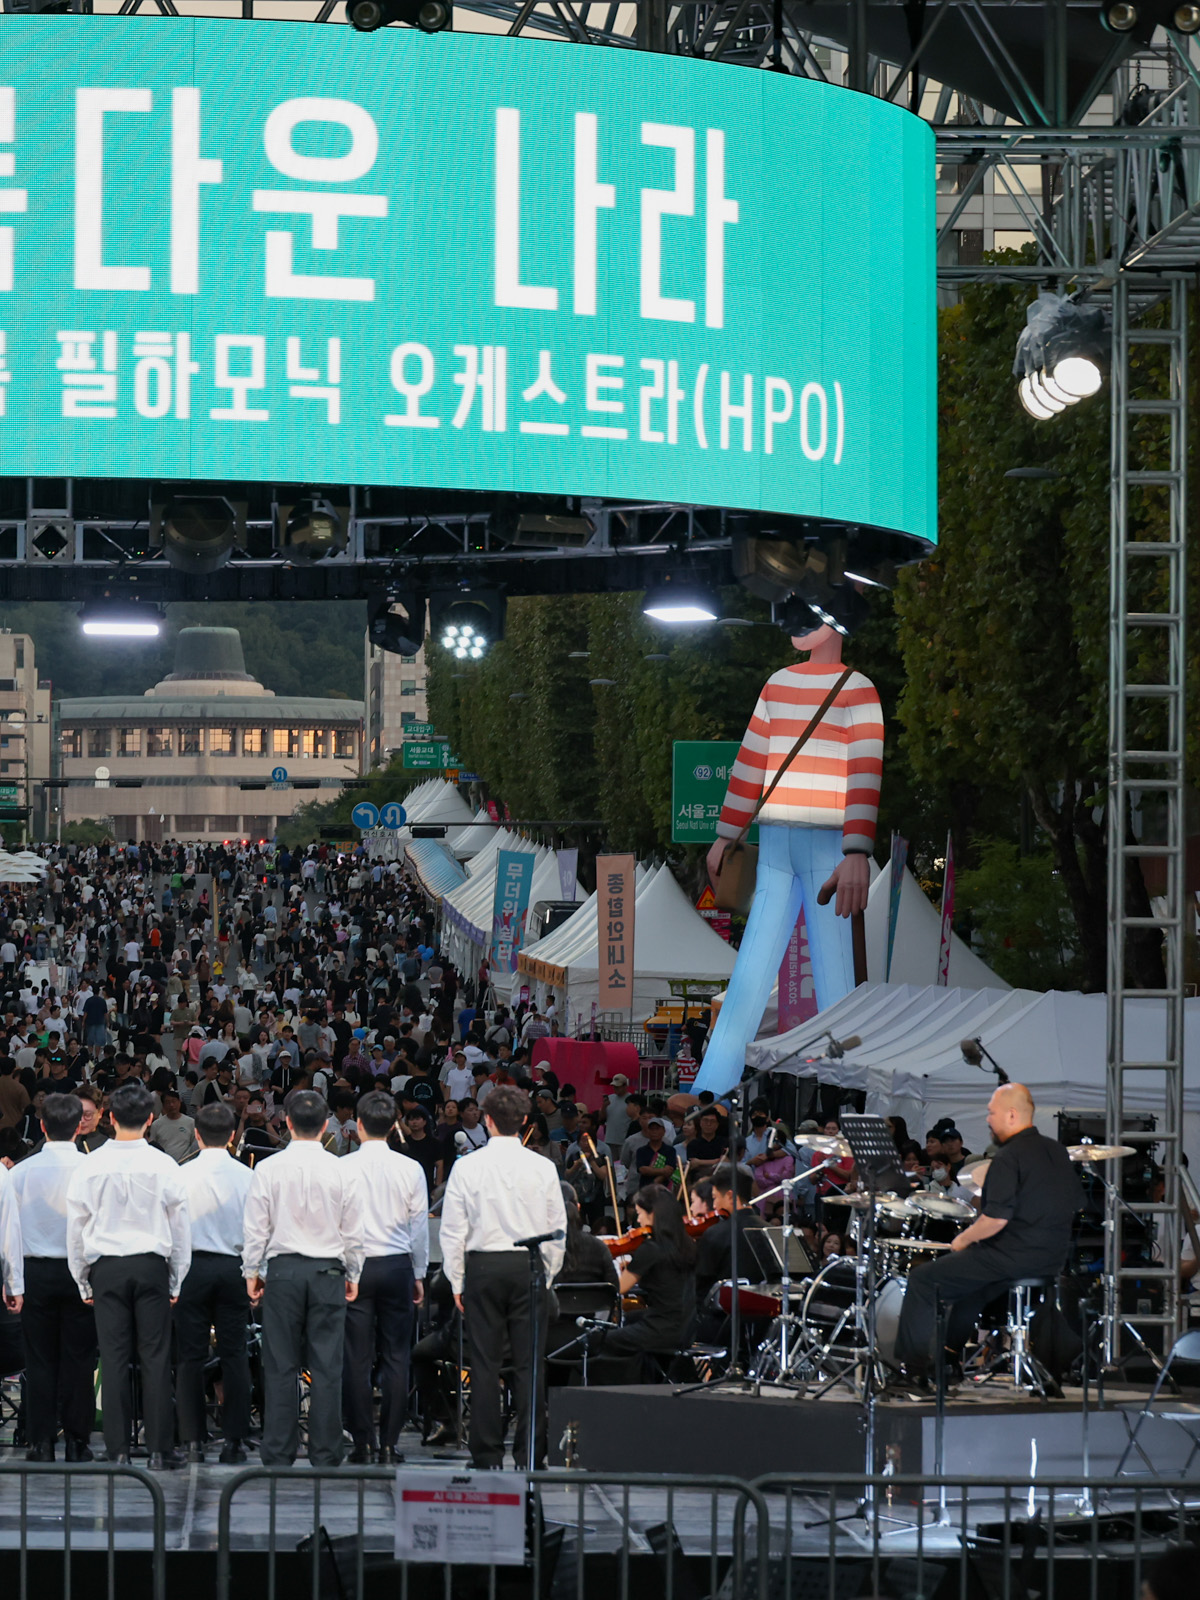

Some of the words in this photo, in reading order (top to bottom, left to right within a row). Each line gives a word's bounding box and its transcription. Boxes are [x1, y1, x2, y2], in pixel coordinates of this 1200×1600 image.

[494, 106, 739, 329] 나라
[55, 329, 342, 425] 필하모닉
[384, 341, 845, 465] 오케스트라(HPO)
[698, 768, 709, 778] 92
[678, 804, 722, 818] 서울교
